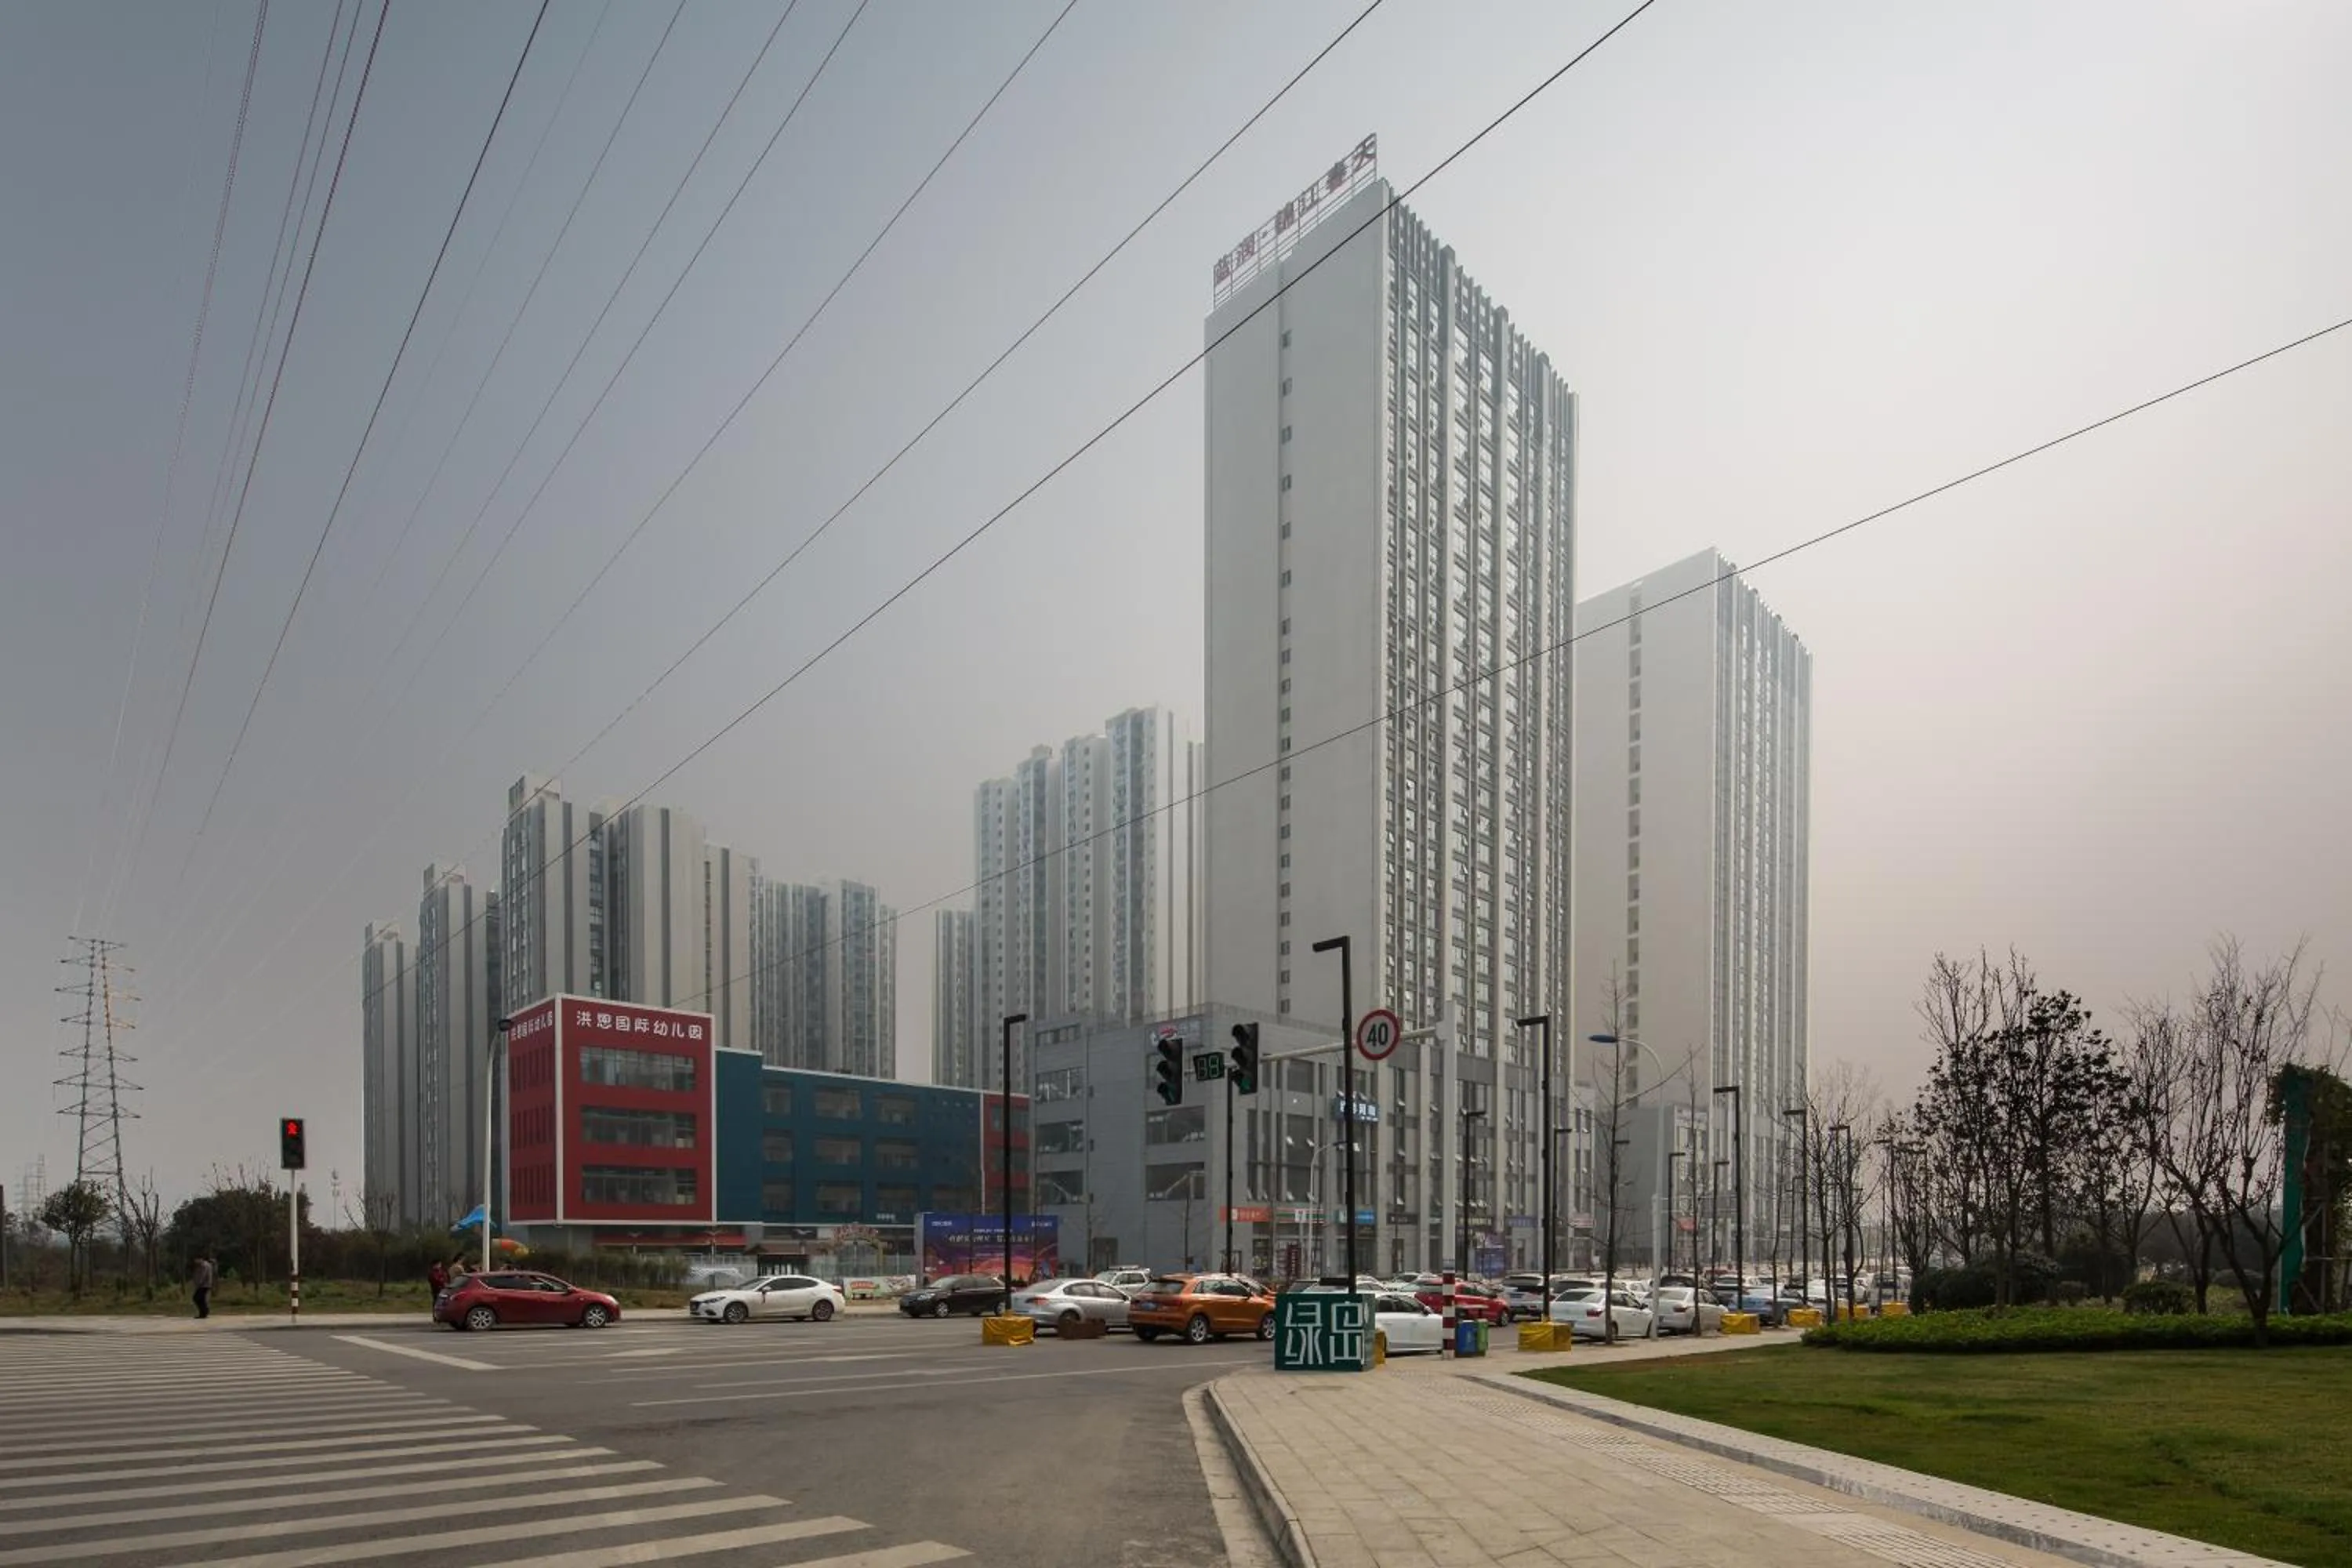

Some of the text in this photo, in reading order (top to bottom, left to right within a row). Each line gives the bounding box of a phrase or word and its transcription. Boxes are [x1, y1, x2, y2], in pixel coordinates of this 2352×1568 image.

[576, 1009, 703, 1040] 洪恩国际幼儿园
[1367, 1022, 1388, 1047] 40
[1285, 1301, 1365, 1365] 绿岛
